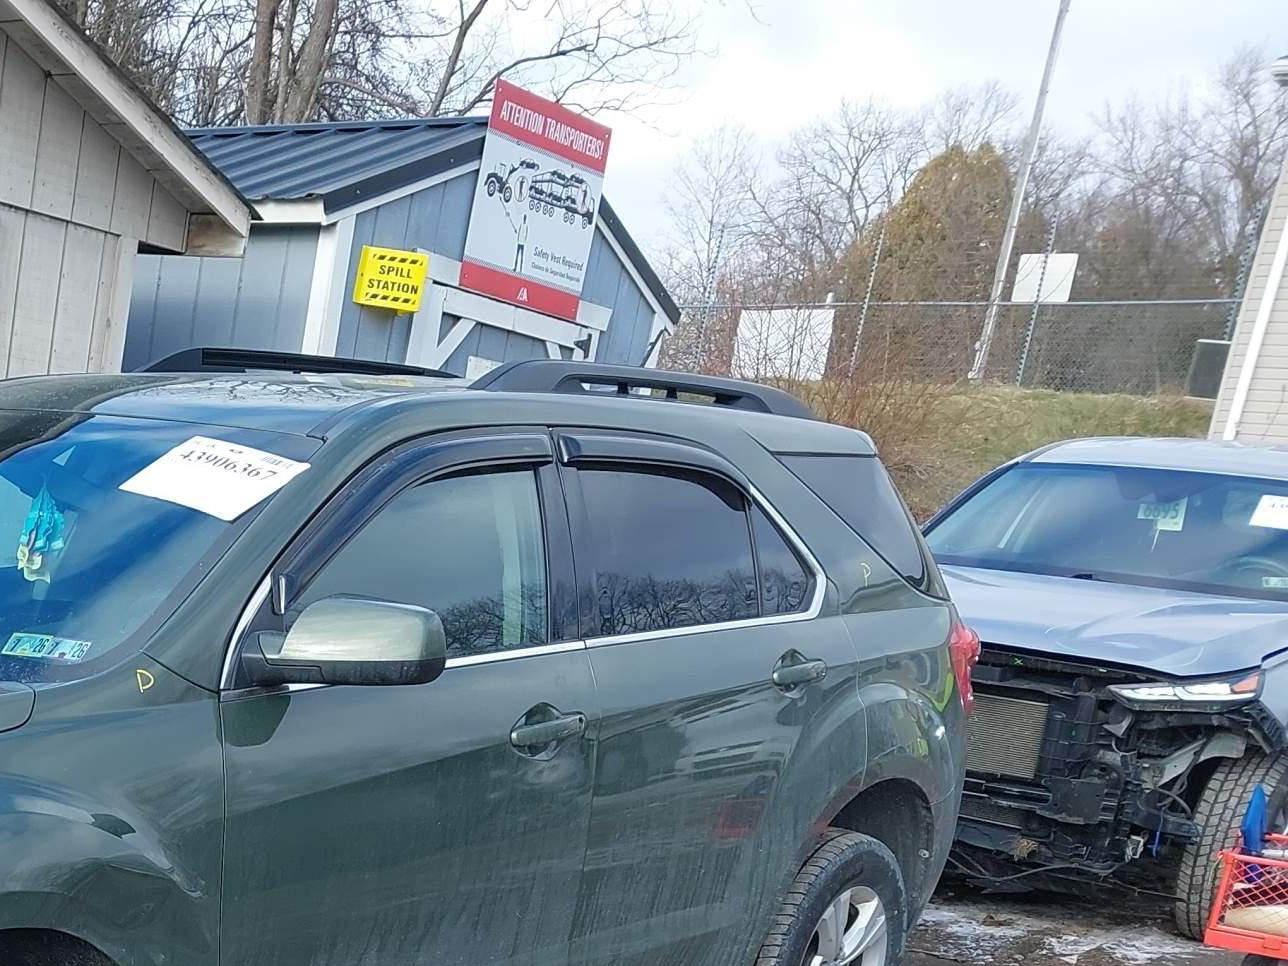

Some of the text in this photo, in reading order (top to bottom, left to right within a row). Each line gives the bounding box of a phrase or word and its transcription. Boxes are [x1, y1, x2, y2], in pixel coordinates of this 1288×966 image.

[499, 100, 605, 160] ATTENTION TRANSPORTERS!
[533, 246, 550, 262] Safety
[378, 264, 413, 279] SPILL
[367, 278, 419, 295] STATION
[180, 449, 278, 481] 43906367
[136, 669, 154, 693] D
